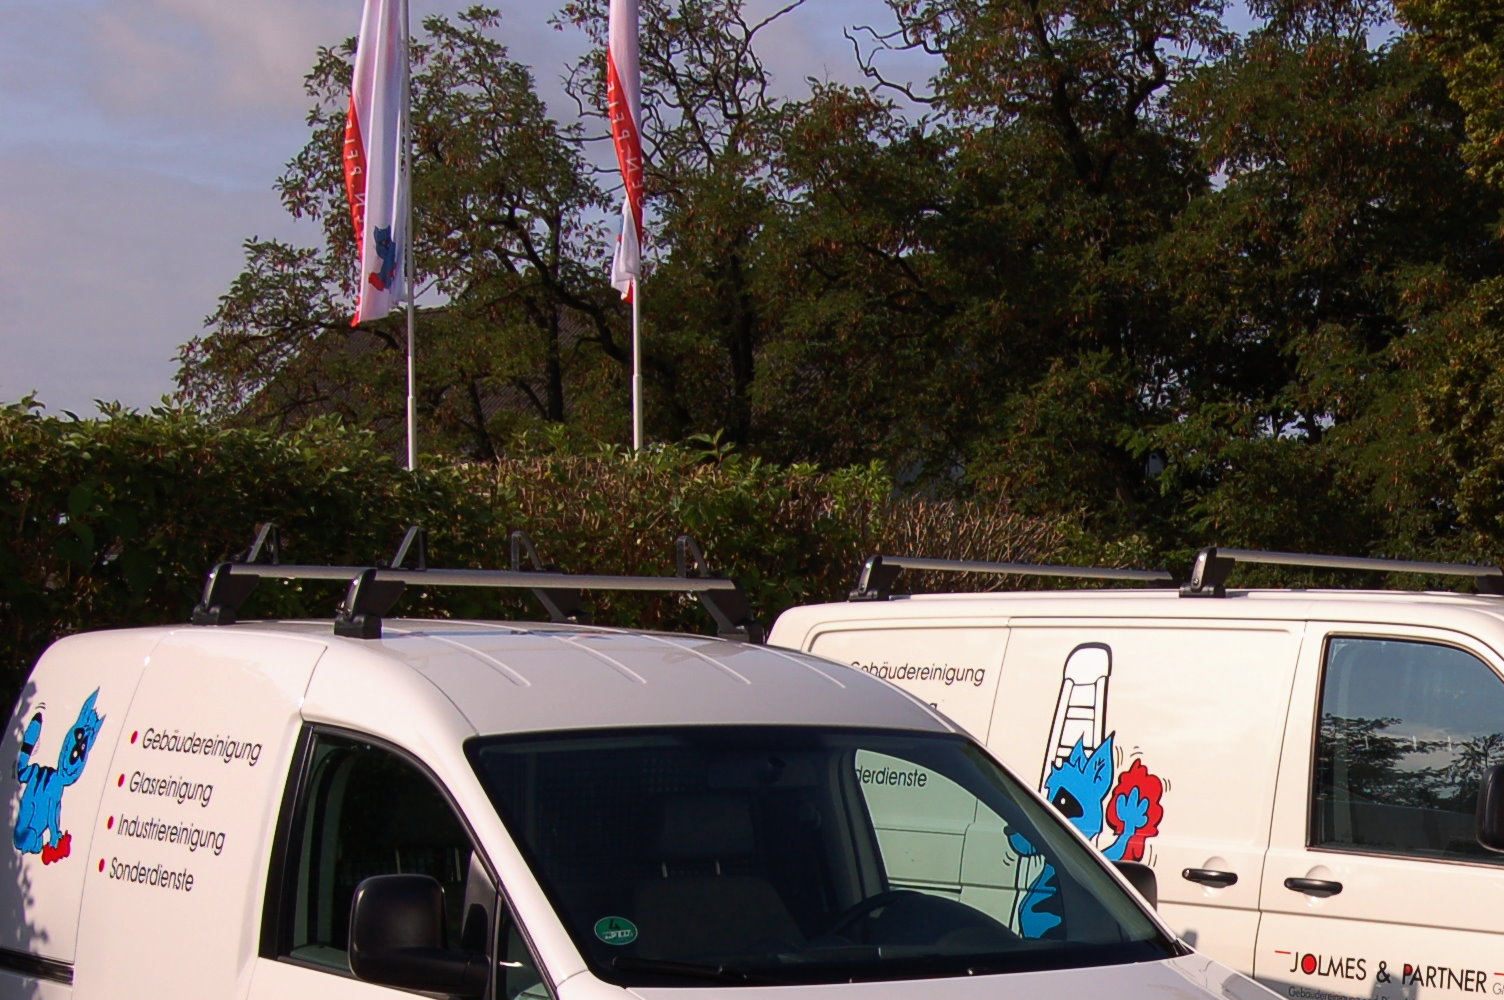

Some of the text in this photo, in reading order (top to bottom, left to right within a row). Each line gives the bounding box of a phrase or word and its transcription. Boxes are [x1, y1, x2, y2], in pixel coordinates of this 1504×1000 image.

[142, 727, 262, 766] Gebäudereinigung
[129, 771, 214, 807] Glasreinigung
[855, 765, 927, 787] derdienste
[117, 813, 226, 856] Industriereinigung
[109, 857, 194, 892] Sonderdienste
[1290, 951, 1367, 981] JOLMES
[1376, 960, 1392, 984] &
[1401, 963, 1488, 994] PARTNER
